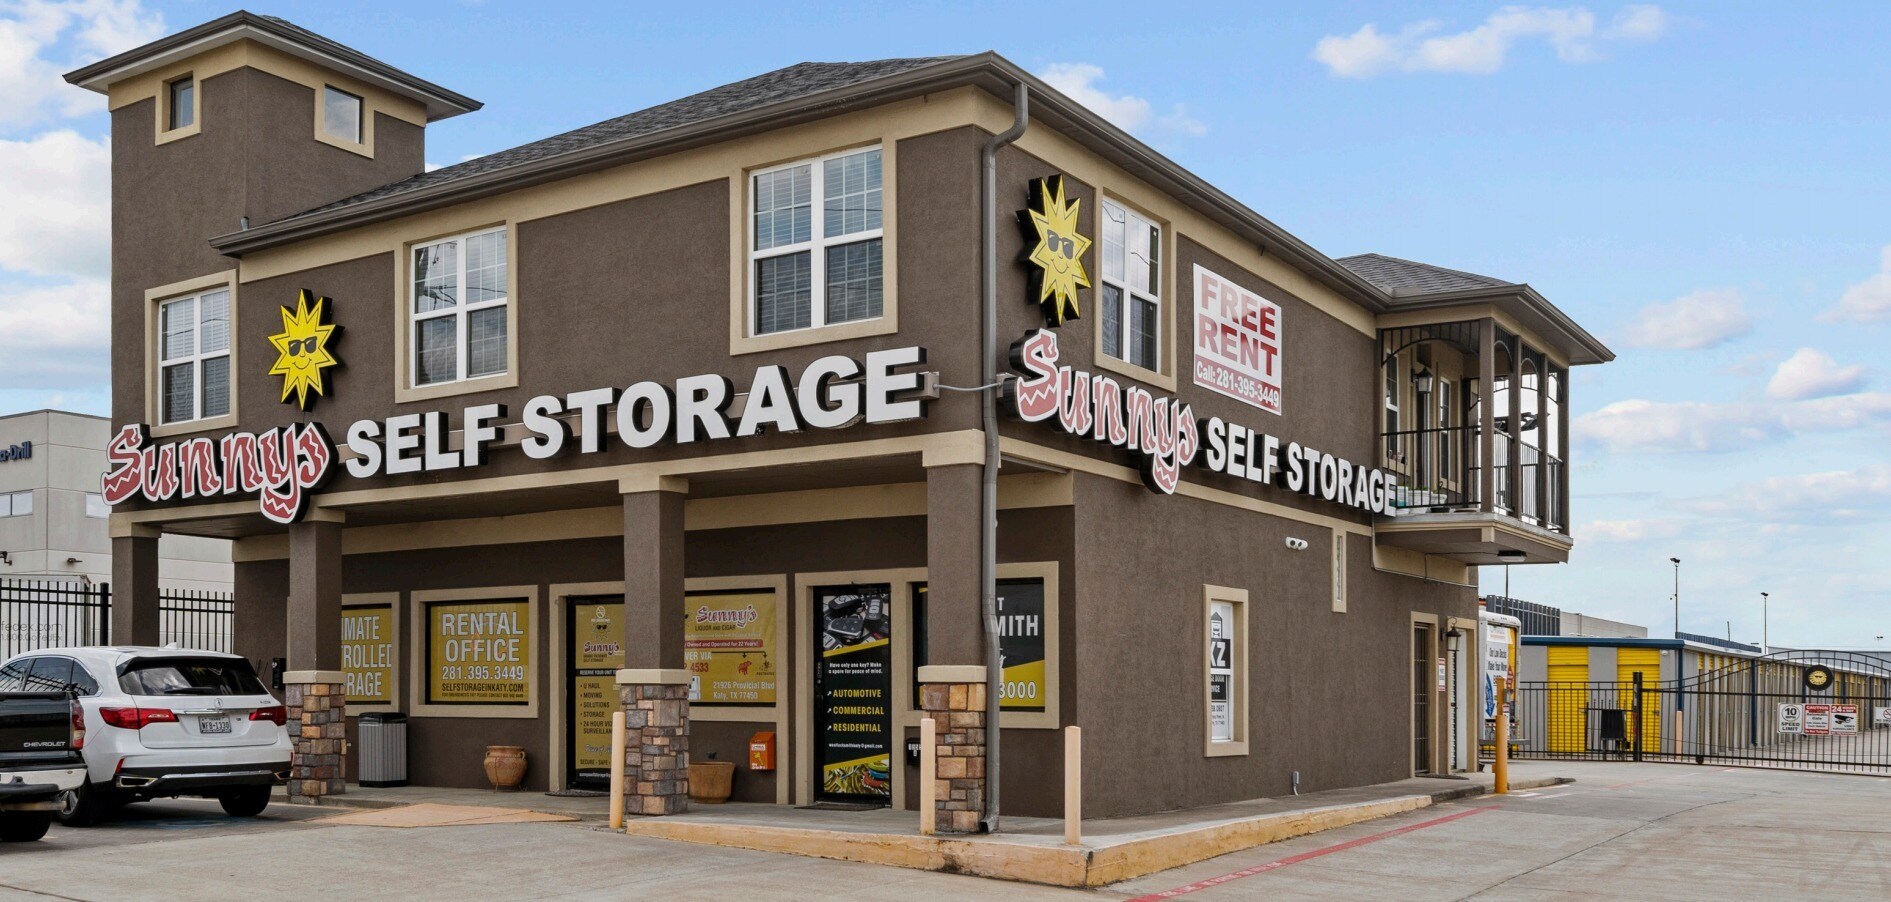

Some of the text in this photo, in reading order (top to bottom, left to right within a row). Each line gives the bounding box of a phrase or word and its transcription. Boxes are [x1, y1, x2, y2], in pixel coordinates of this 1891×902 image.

[1202, 273, 1276, 340] FREE
[1199, 313, 1278, 376] RENT
[1197, 360, 1280, 408] Call: 281-395-3449
[345, 403, 502, 479] SELF
[521, 346, 923, 459] STORAGE
[1207, 417, 1279, 484] SELF
[1287, 442, 1397, 517] STORAGE
[341, 615, 379, 640] IMATE
[441, 611, 524, 637] RENTAL
[697, 604, 757, 628] Sunny's
[997, 615, 1039, 636] MITH
[341, 644, 392, 668] ROLLED
[445, 638, 520, 662] OFFICE
[700, 651, 712, 660] VIA
[441, 665, 524, 680] 281.395.3449
[691, 662, 709, 672] 4533
[346, 671, 382, 697] RAGE
[441, 682, 524, 692] SELFSTORAGEINKATY.COM
[833, 689, 882, 698] AUTOMOTIVE
[833, 706, 885, 715] COMMERCIAL
[1785, 708, 1797, 716] 10
[833, 723, 882, 732] RESIDENTIAL
